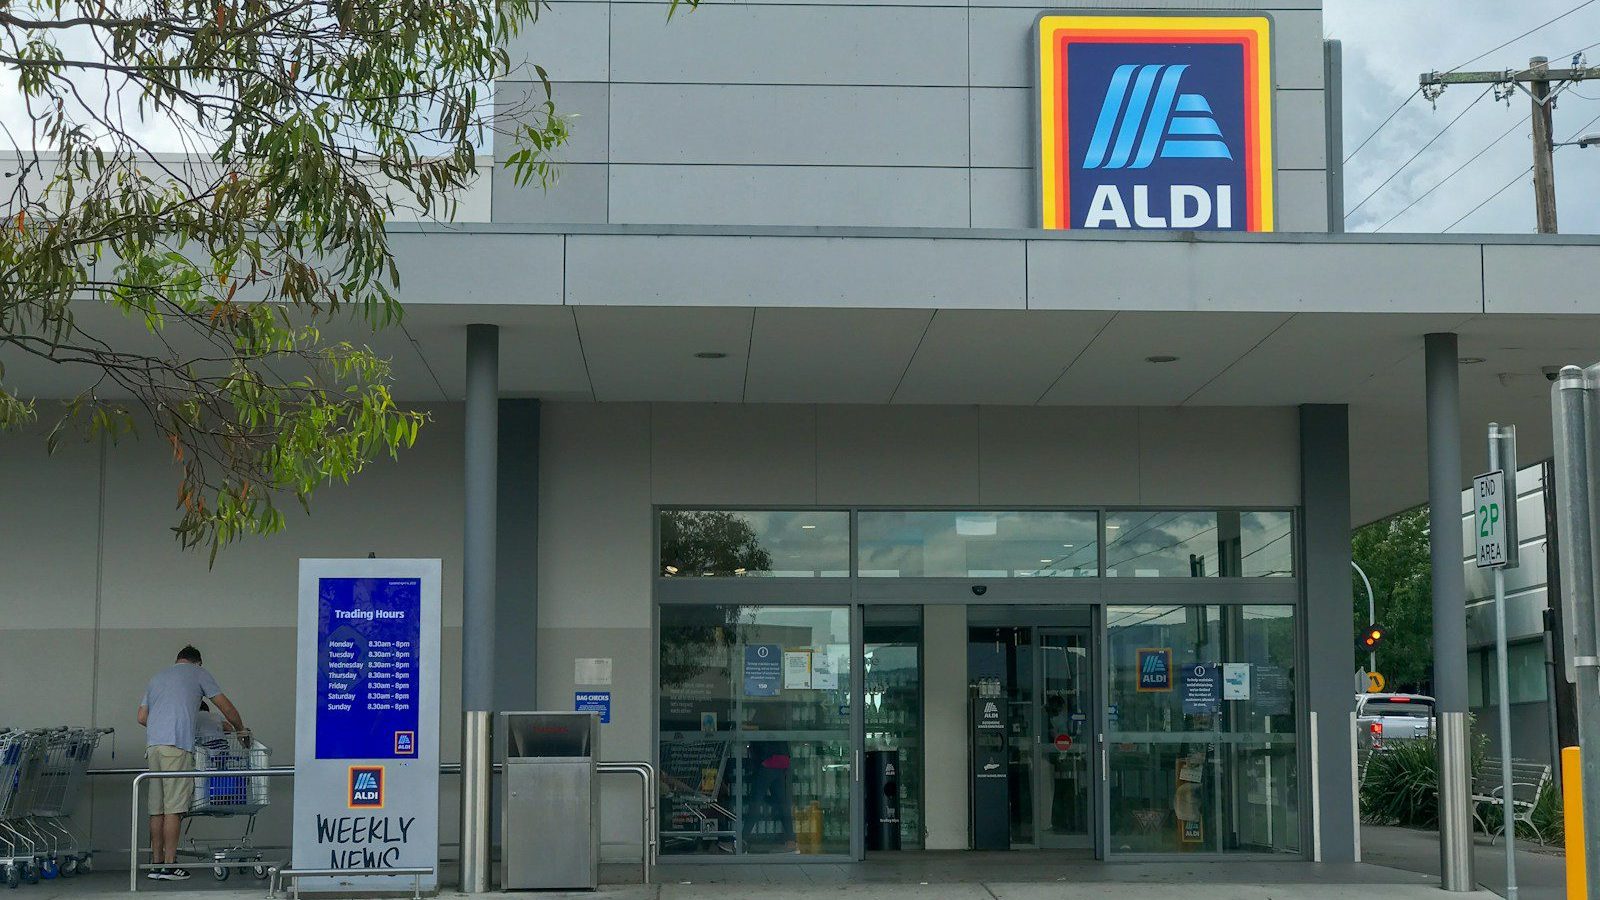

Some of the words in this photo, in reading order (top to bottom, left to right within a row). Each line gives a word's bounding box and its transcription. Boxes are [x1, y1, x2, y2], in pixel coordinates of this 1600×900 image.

[1084, 184, 1232, 228] ALDI
[1481, 479, 1496, 497] END
[1480, 503, 1499, 538] 2P
[1481, 543, 1502, 561] AREA
[334, 609, 374, 621] Trading
[375, 609, 405, 619] Hours
[329, 640, 354, 649] Monday
[395, 640, 410, 649] 8pm
[329, 650, 355, 659] Tuesday
[395, 650, 410, 659] 8pm
[329, 661, 364, 670] Wednesday
[395, 661, 410, 670] 8pm
[328, 672, 357, 681] Thursday
[395, 672, 410, 681] 8pm
[1142, 674, 1167, 683] ALDI
[328, 682, 348, 691] Friday
[395, 682, 410, 691] 8pm
[328, 692, 356, 701] Saturday
[395, 692, 410, 701] 8pm
[327, 703, 352, 712] Sunday
[395, 703, 410, 712] 8pm
[353, 791, 379, 800] ALDI
[316, 814, 416, 844] WEEKLY
[330, 847, 400, 869] NEWS
